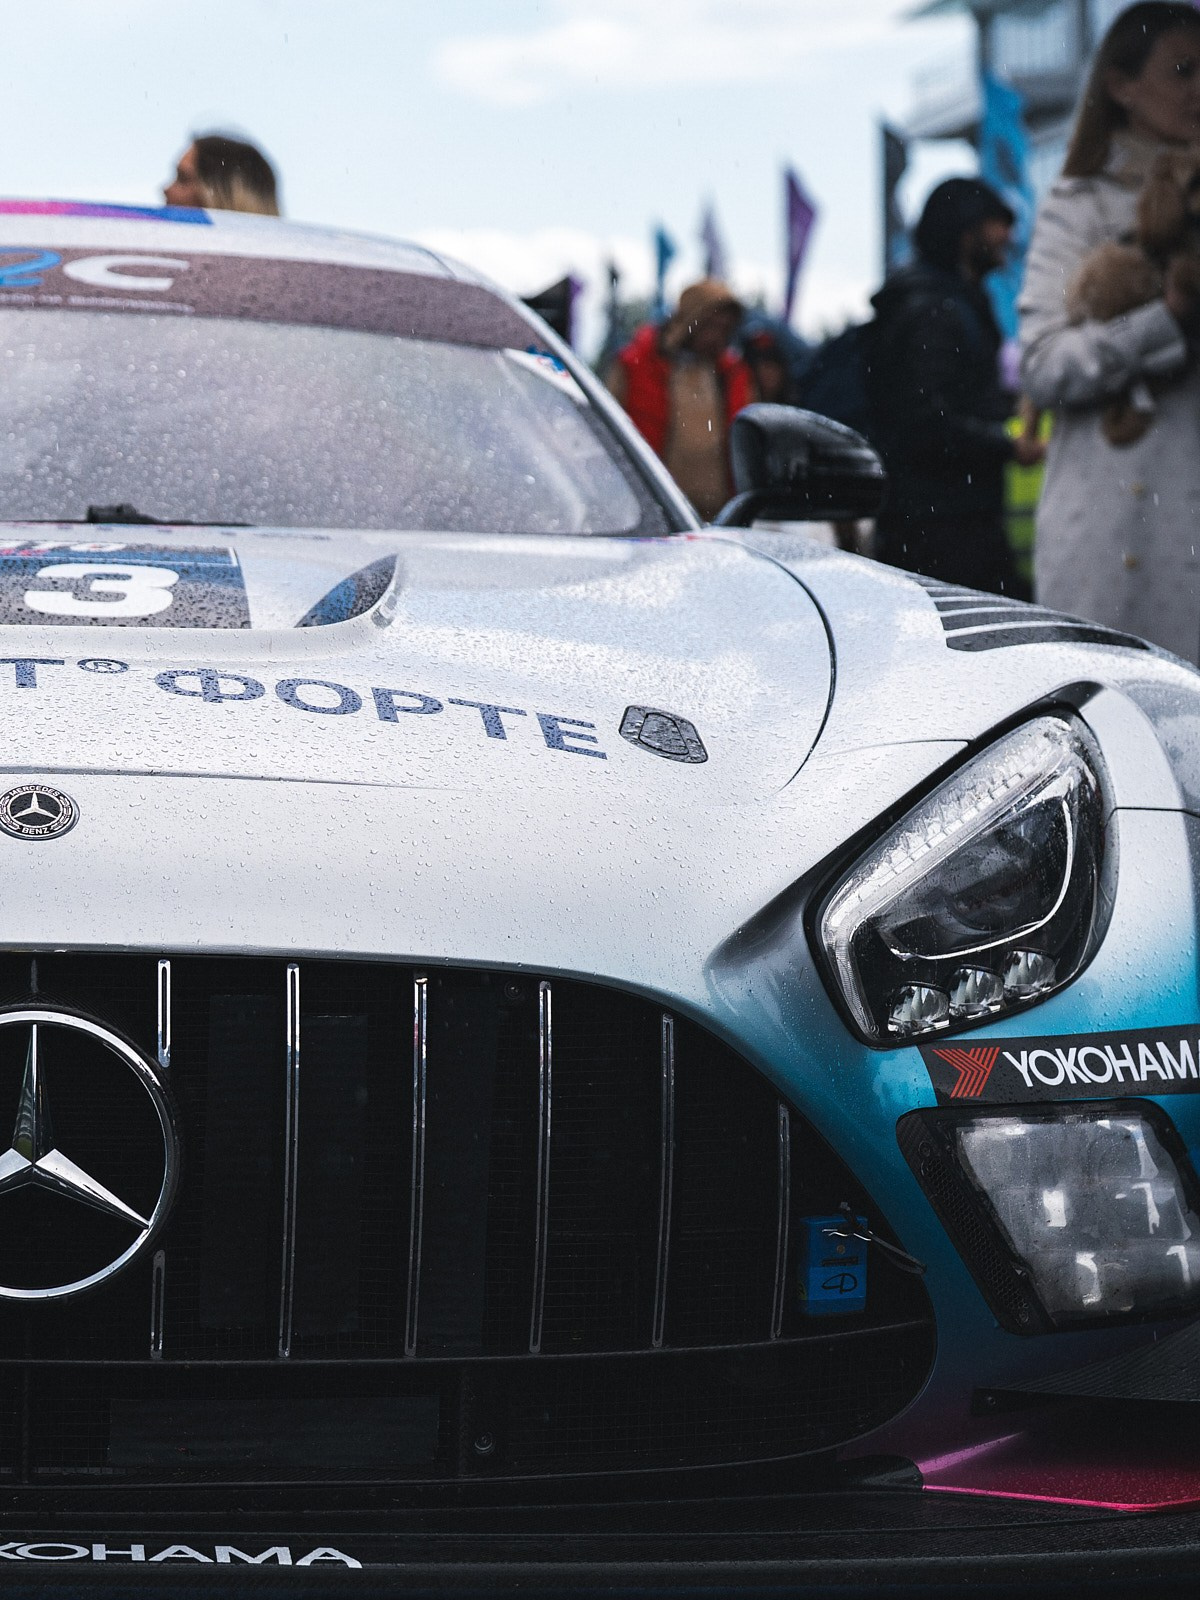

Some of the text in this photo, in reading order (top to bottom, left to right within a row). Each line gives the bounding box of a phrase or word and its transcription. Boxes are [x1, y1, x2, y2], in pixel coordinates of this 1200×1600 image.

[154, 668, 608, 760] ФОРТЕ
[9, 785, 61, 797] MERCEDES
[21, 827, 50, 835] BENZ
[1002, 1039, 1200, 1087] YOKOHAM
